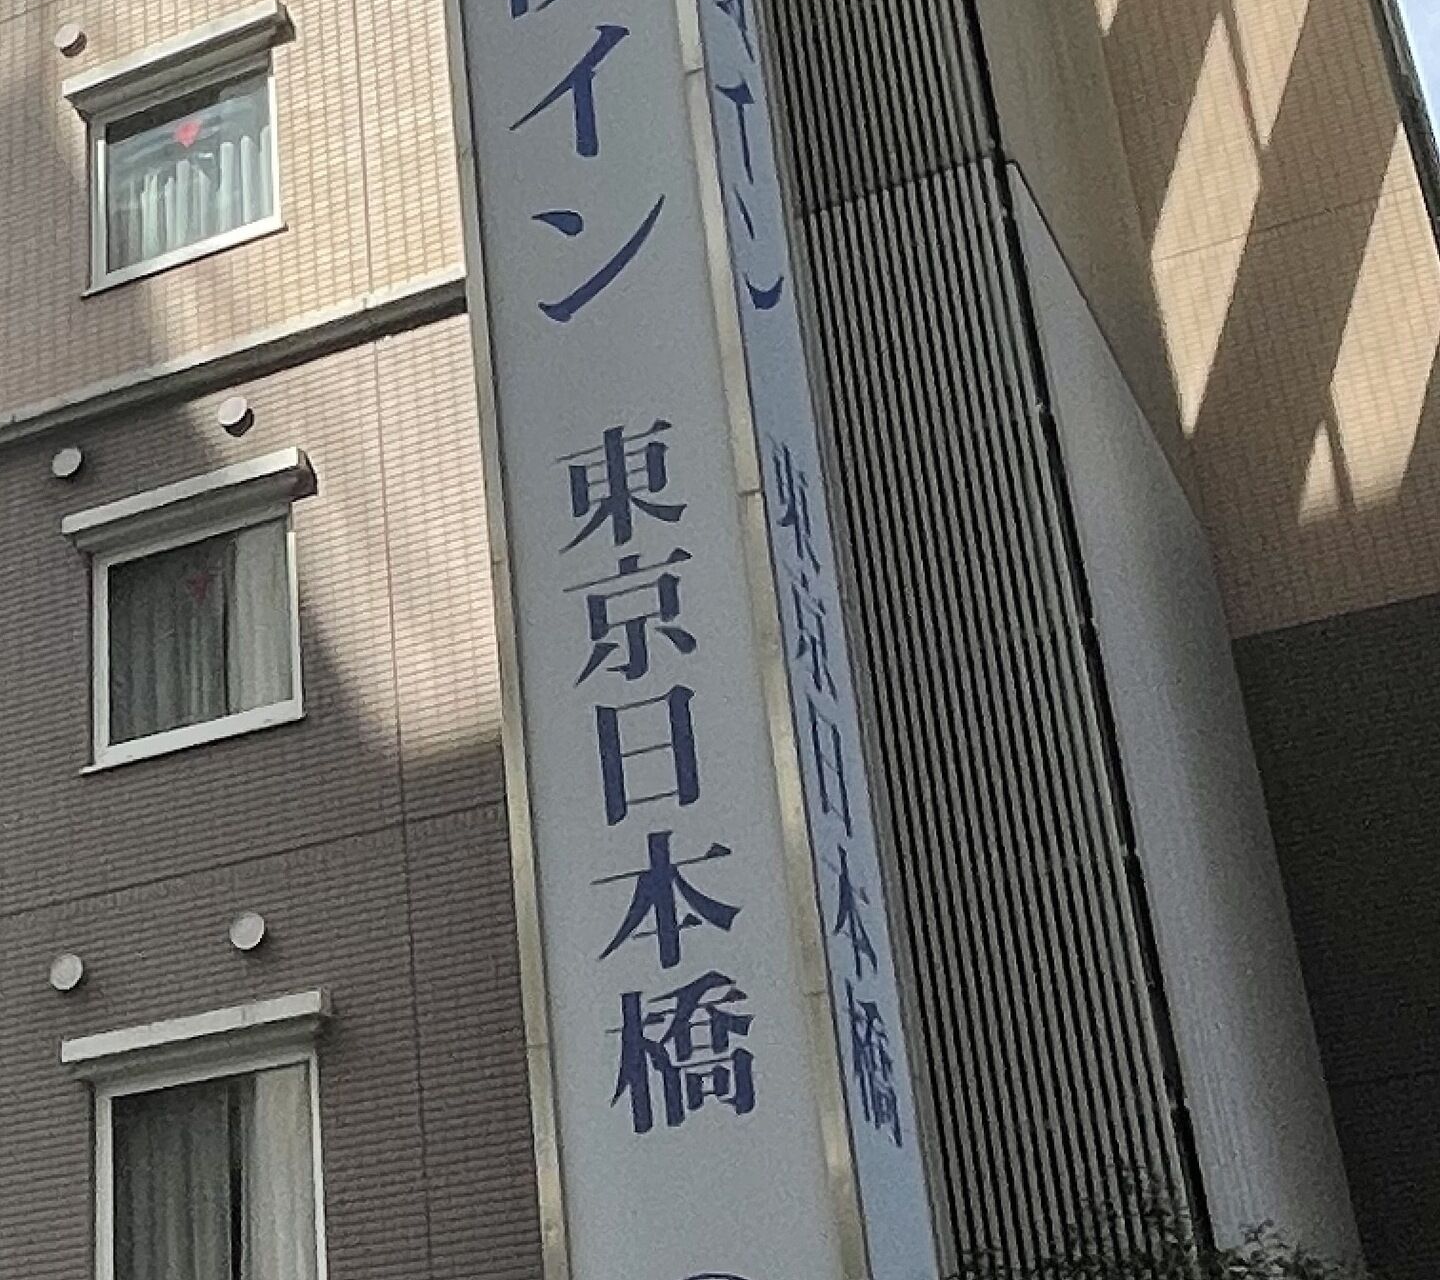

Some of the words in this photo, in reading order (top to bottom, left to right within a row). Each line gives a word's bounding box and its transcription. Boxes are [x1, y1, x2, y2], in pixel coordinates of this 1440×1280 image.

[555, 419, 754, 1134] 東京日本橋
